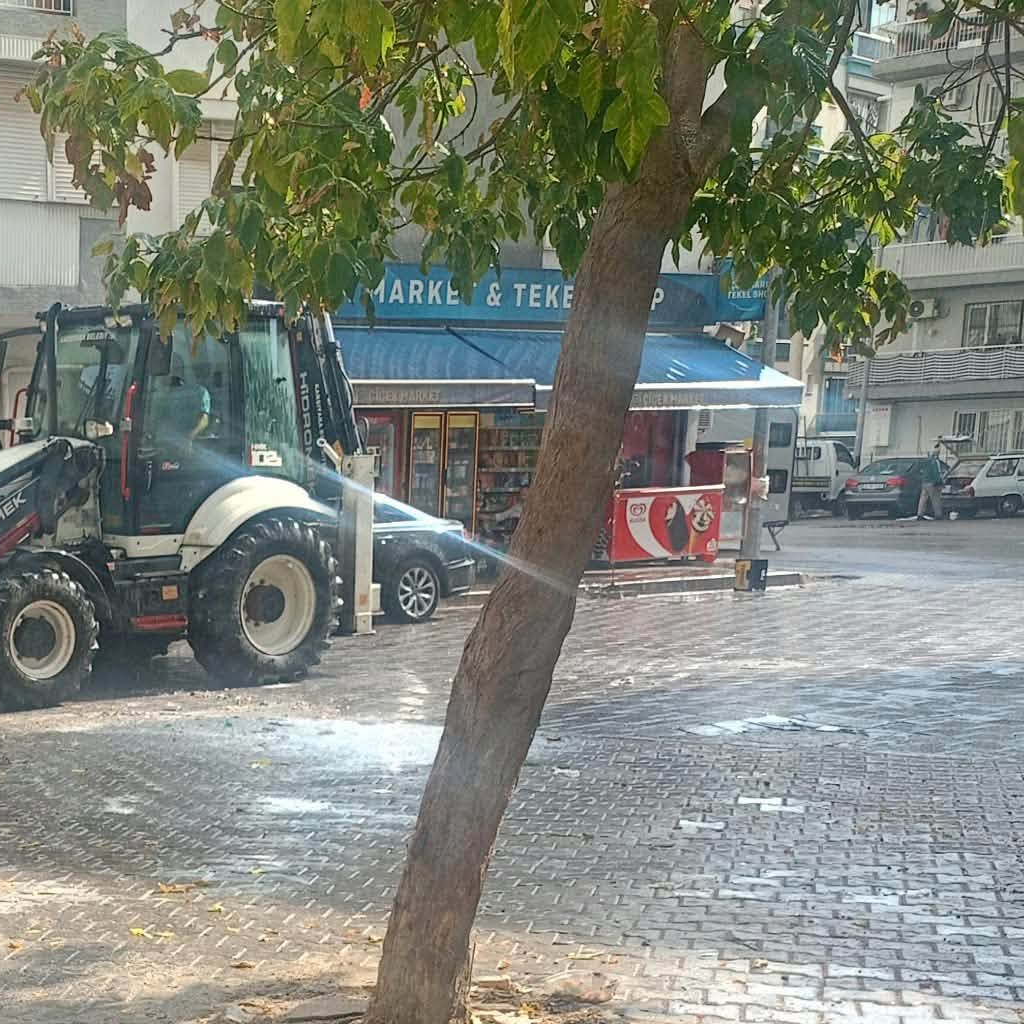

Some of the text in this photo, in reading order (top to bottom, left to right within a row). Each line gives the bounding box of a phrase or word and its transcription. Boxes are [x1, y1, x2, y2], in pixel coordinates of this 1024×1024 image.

[365, 279, 574, 309] MARKE & TEKE
[753, 289, 768, 298] SHO
